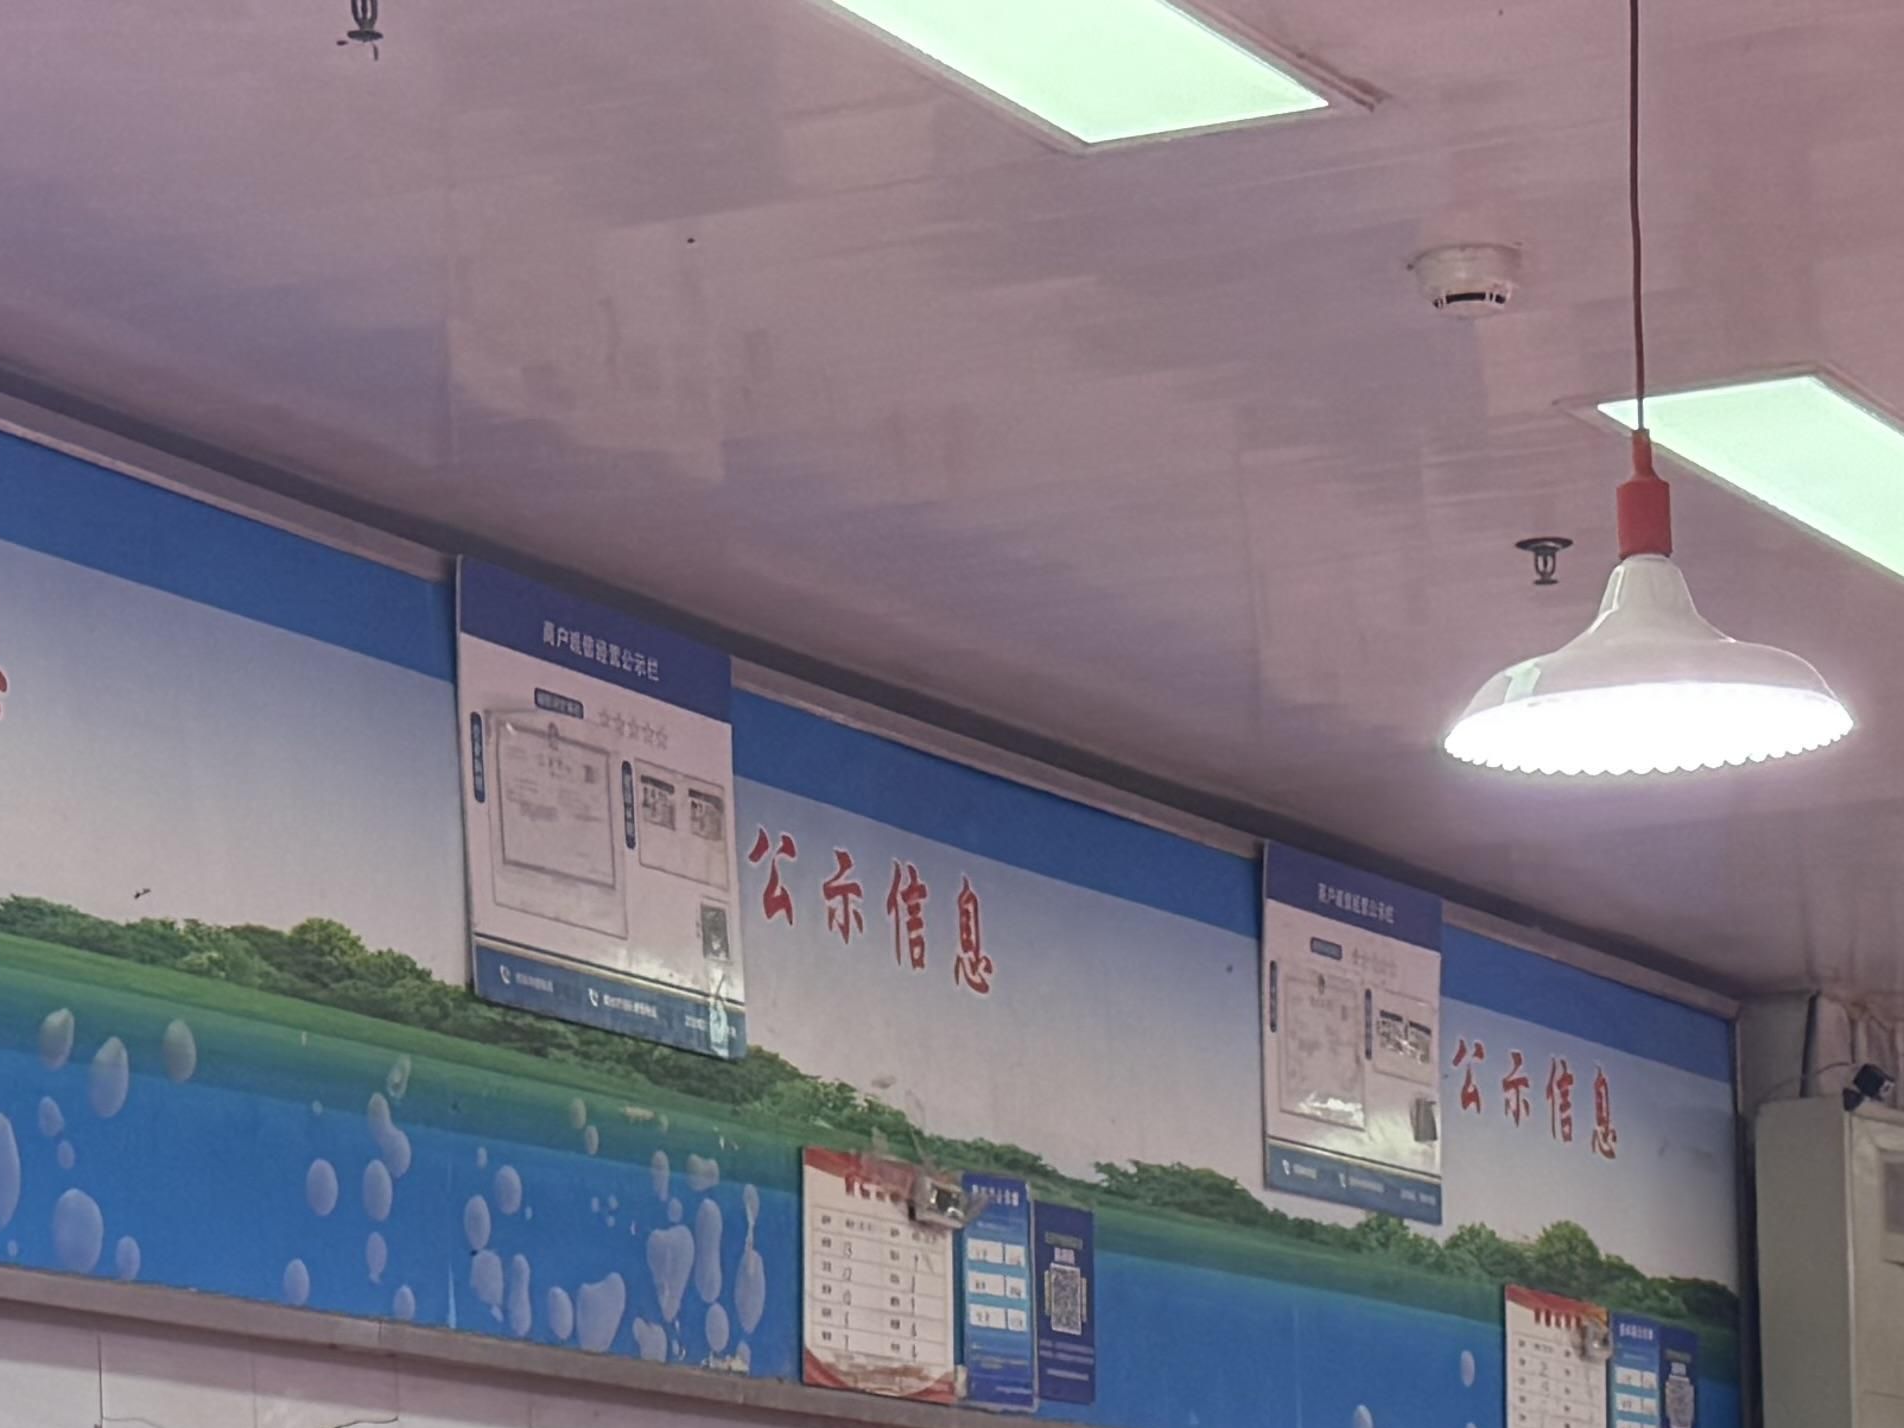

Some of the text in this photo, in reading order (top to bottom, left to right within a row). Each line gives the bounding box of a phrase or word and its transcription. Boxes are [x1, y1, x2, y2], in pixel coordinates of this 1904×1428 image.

[748, 825, 993, 995] 公示信息
[1453, 1039, 1618, 1160] 公示信息
